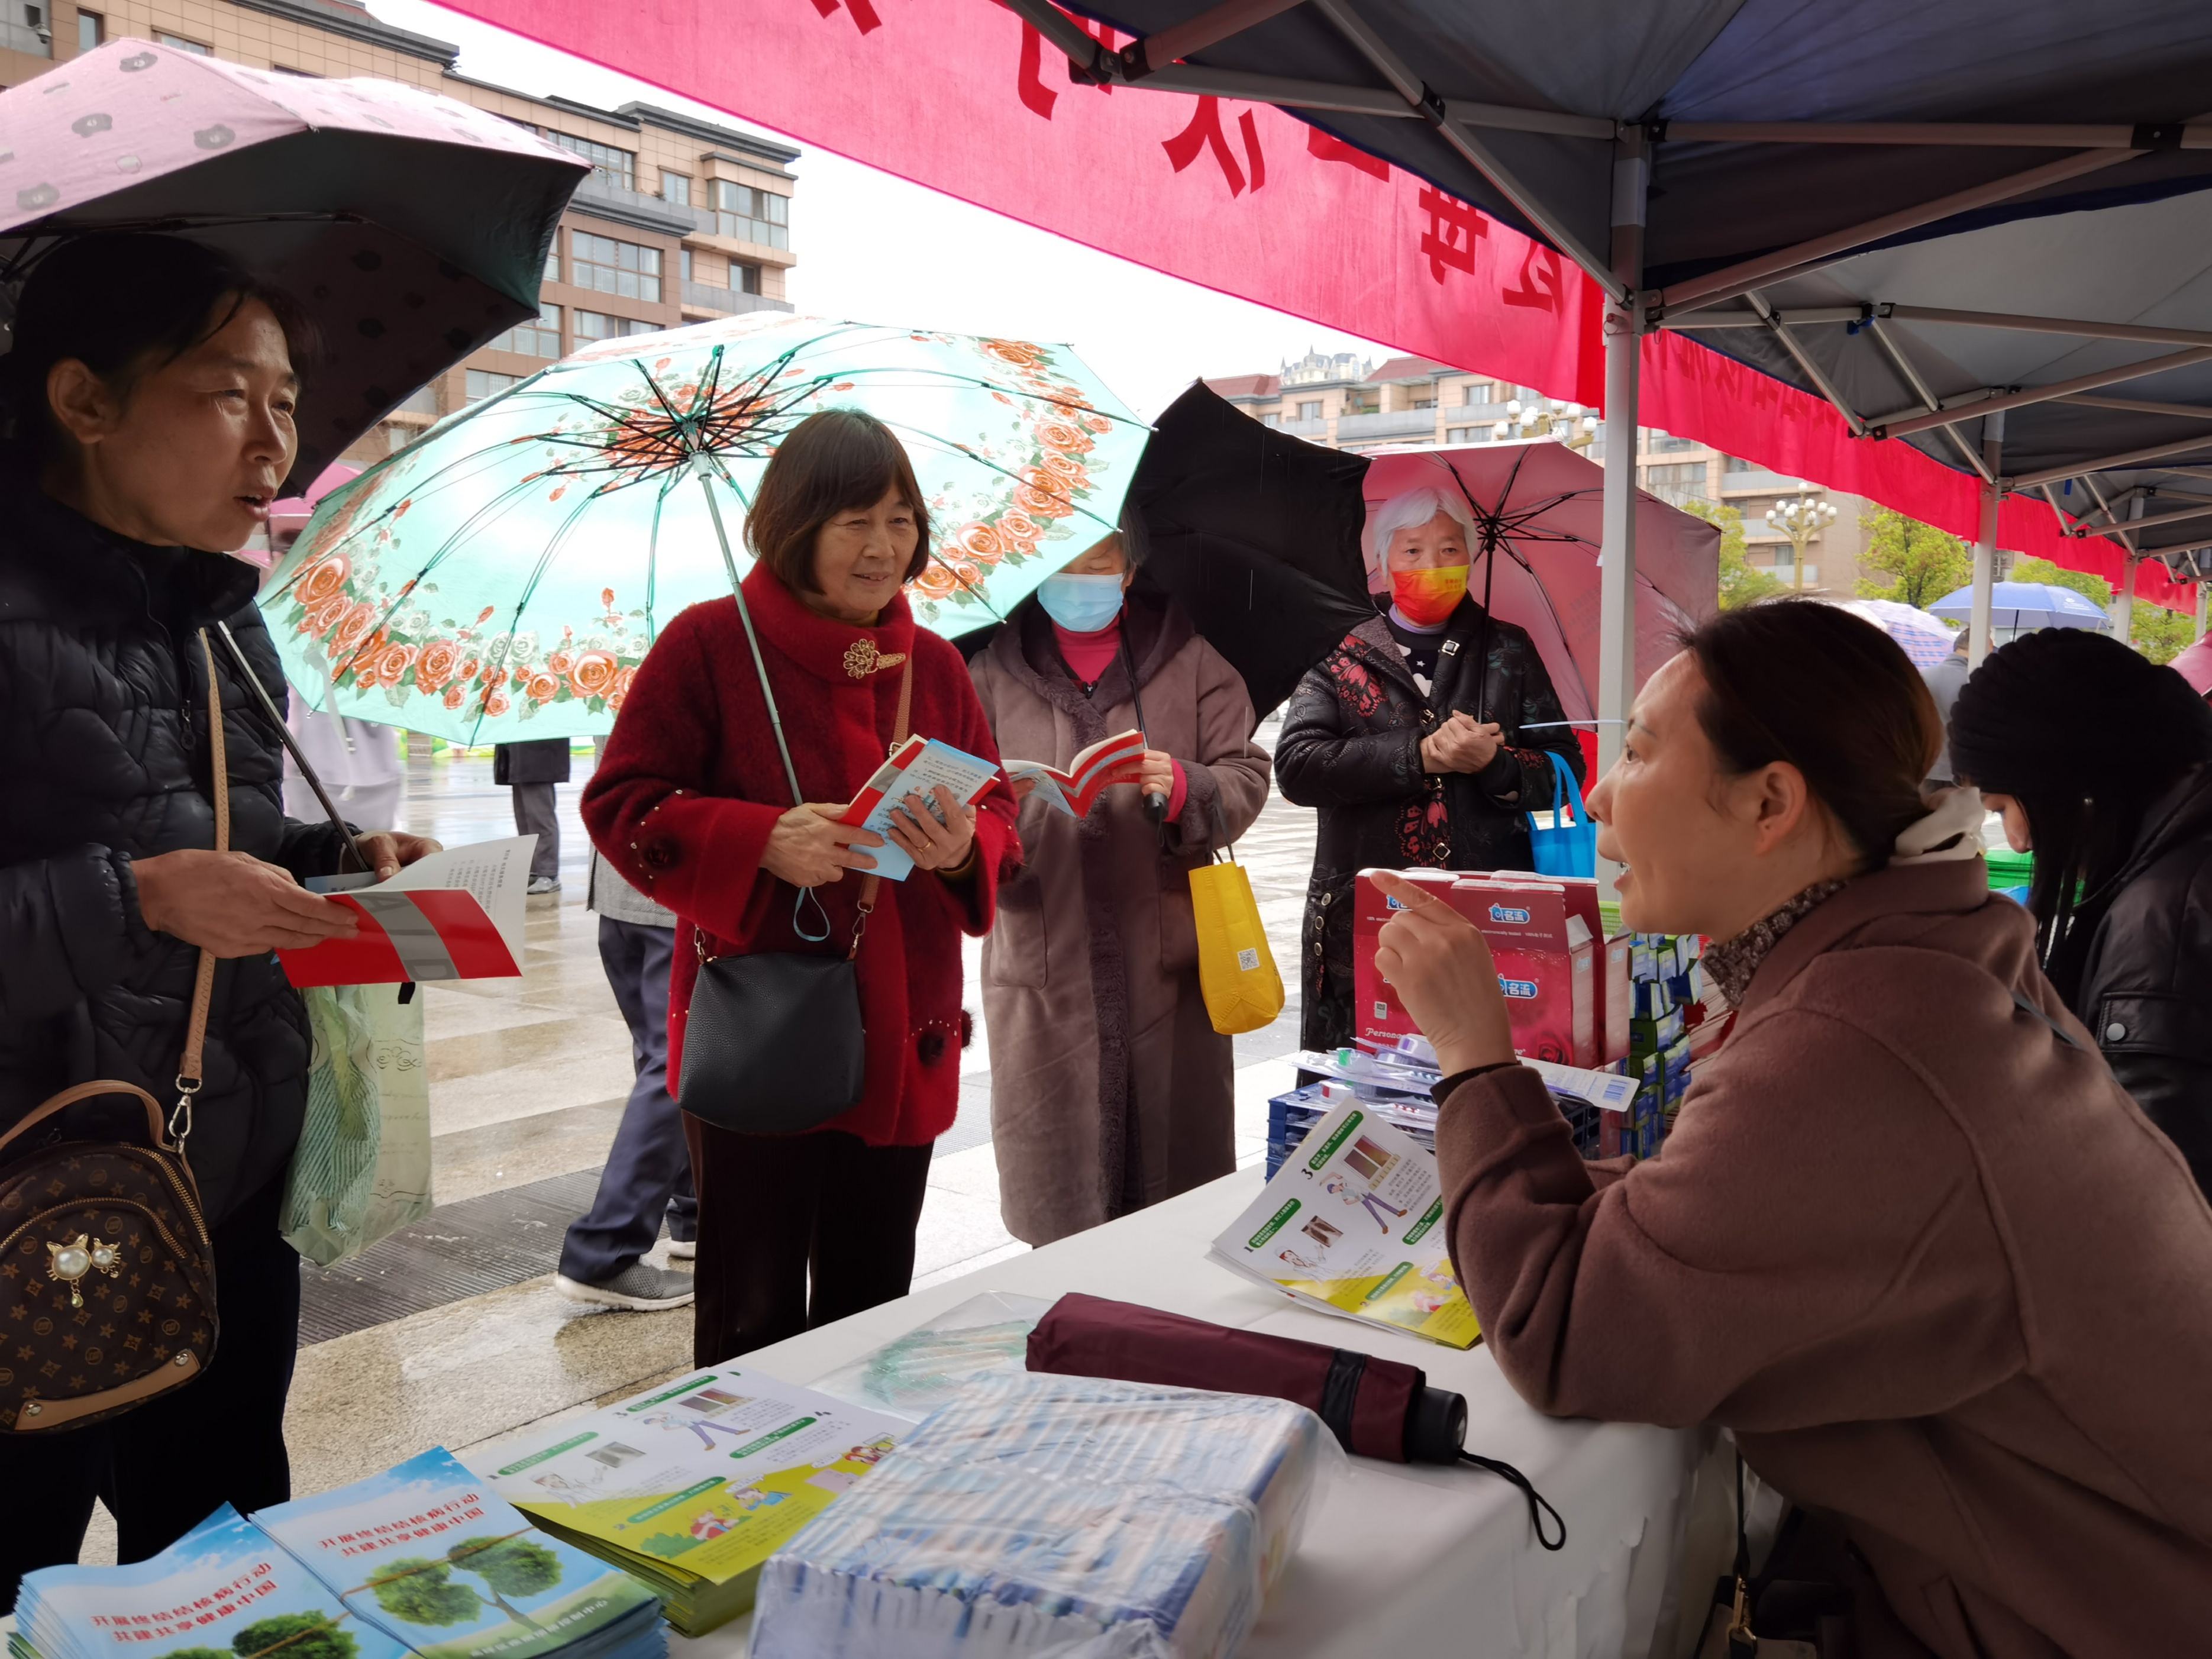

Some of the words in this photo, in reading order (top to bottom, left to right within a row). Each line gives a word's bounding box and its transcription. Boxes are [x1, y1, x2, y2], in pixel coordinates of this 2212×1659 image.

[1504, 910, 1524, 922] 名流
[1508, 982, 1531, 996] 名流
[1301, 1168, 1313, 1180] 3
[318, 1492, 480, 1550] 开展终结结核病行动
[340, 1506, 485, 1558] 共建共享健康中国
[90, 1561, 273, 1627] 开展终结结核病行动
[112, 1579, 278, 1642] 共建共享健康中国
